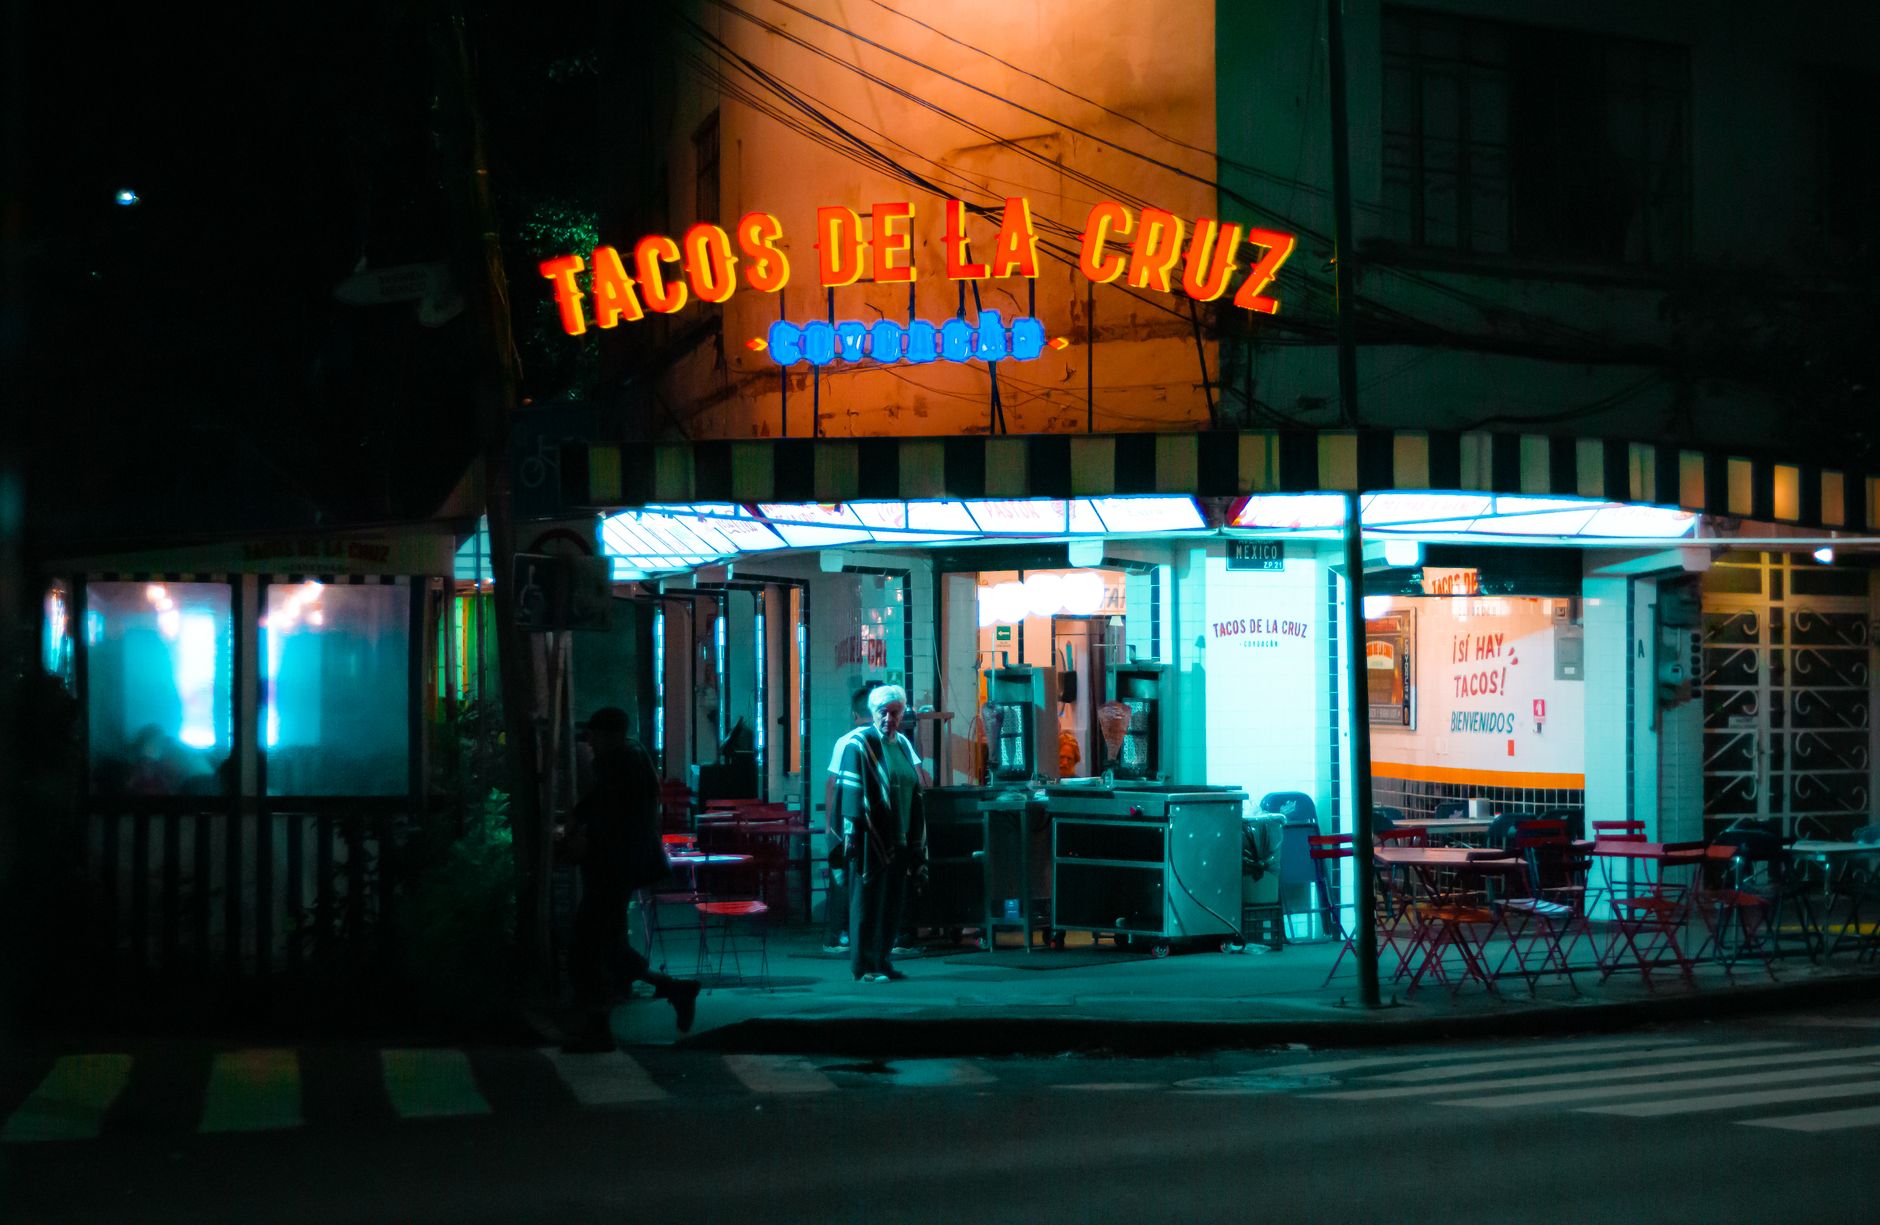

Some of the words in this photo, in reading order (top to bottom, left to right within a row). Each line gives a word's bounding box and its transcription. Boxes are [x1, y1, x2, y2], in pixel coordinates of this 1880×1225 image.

[539, 211, 790, 336] TACOS
[813, 202, 917, 287] DE
[940, 197, 1039, 280] LA
[1078, 201, 1296, 314] CRUZ
[1212, 619, 1246, 638] TACOS
[1249, 619, 1262, 634] DE
[1266, 619, 1279, 634] LA
[1281, 620, 1308, 638] CRUZ
[1476, 633, 1504, 661] HAY
[1453, 667, 1507, 698] TACOS!
[1450, 711, 1515, 734] BIENVENIDOS
